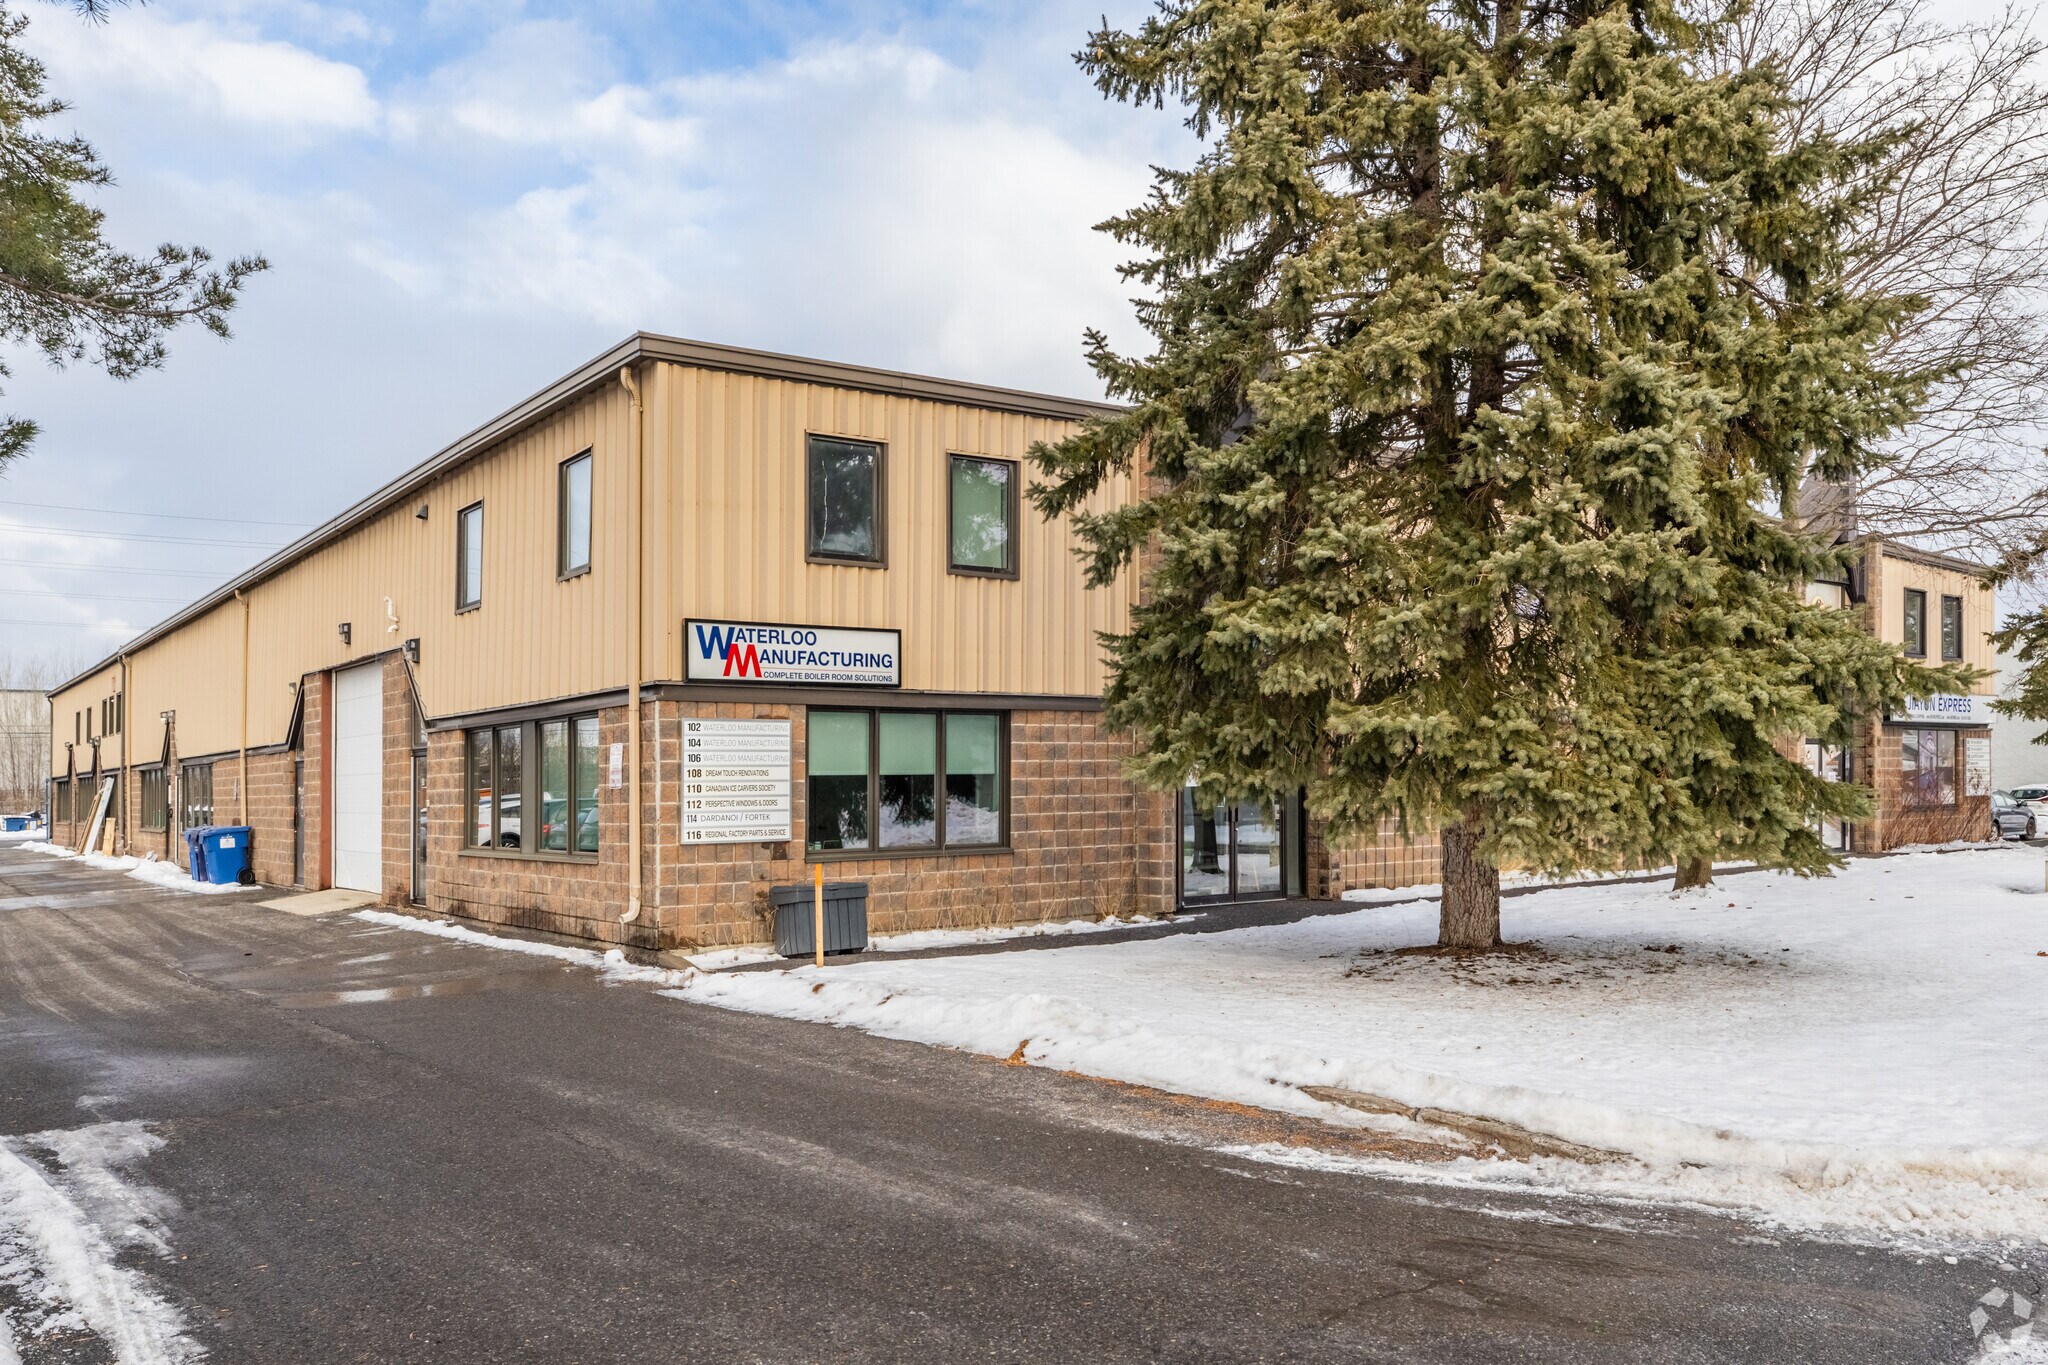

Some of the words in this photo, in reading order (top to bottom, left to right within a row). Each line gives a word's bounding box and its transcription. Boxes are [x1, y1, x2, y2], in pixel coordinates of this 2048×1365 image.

[695, 624, 817, 660] WATERLOO
[723, 643, 893, 678] MANUFACTURING
[763, 671, 804, 680] COMPLETE
[804, 672, 831, 681] BOILER
[831, 673, 853, 681] ROOM
[854, 674, 893, 682] SOLUTIONS
[1938, 697, 1972, 713] EXPRESS
[687, 723, 701, 732] 102
[703, 723, 736, 732] WATERLOO
[737, 724, 789, 732] MANUFACTURING
[687, 738, 701, 747] 104
[703, 739, 736, 747] WATERLOO
[737, 739, 789, 747] MANUFACTURING
[687, 754, 701, 763] 106
[703, 754, 736, 762] WATERLOO
[737, 754, 789, 762] MANUFACTURING
[687, 769, 702, 778] 108
[687, 784, 702, 793] 110
[687, 800, 702, 809] 112
[705, 800, 735, 808] PERSPECTIVE
[687, 814, 697, 823] 114
[687, 831, 702, 840] 116
